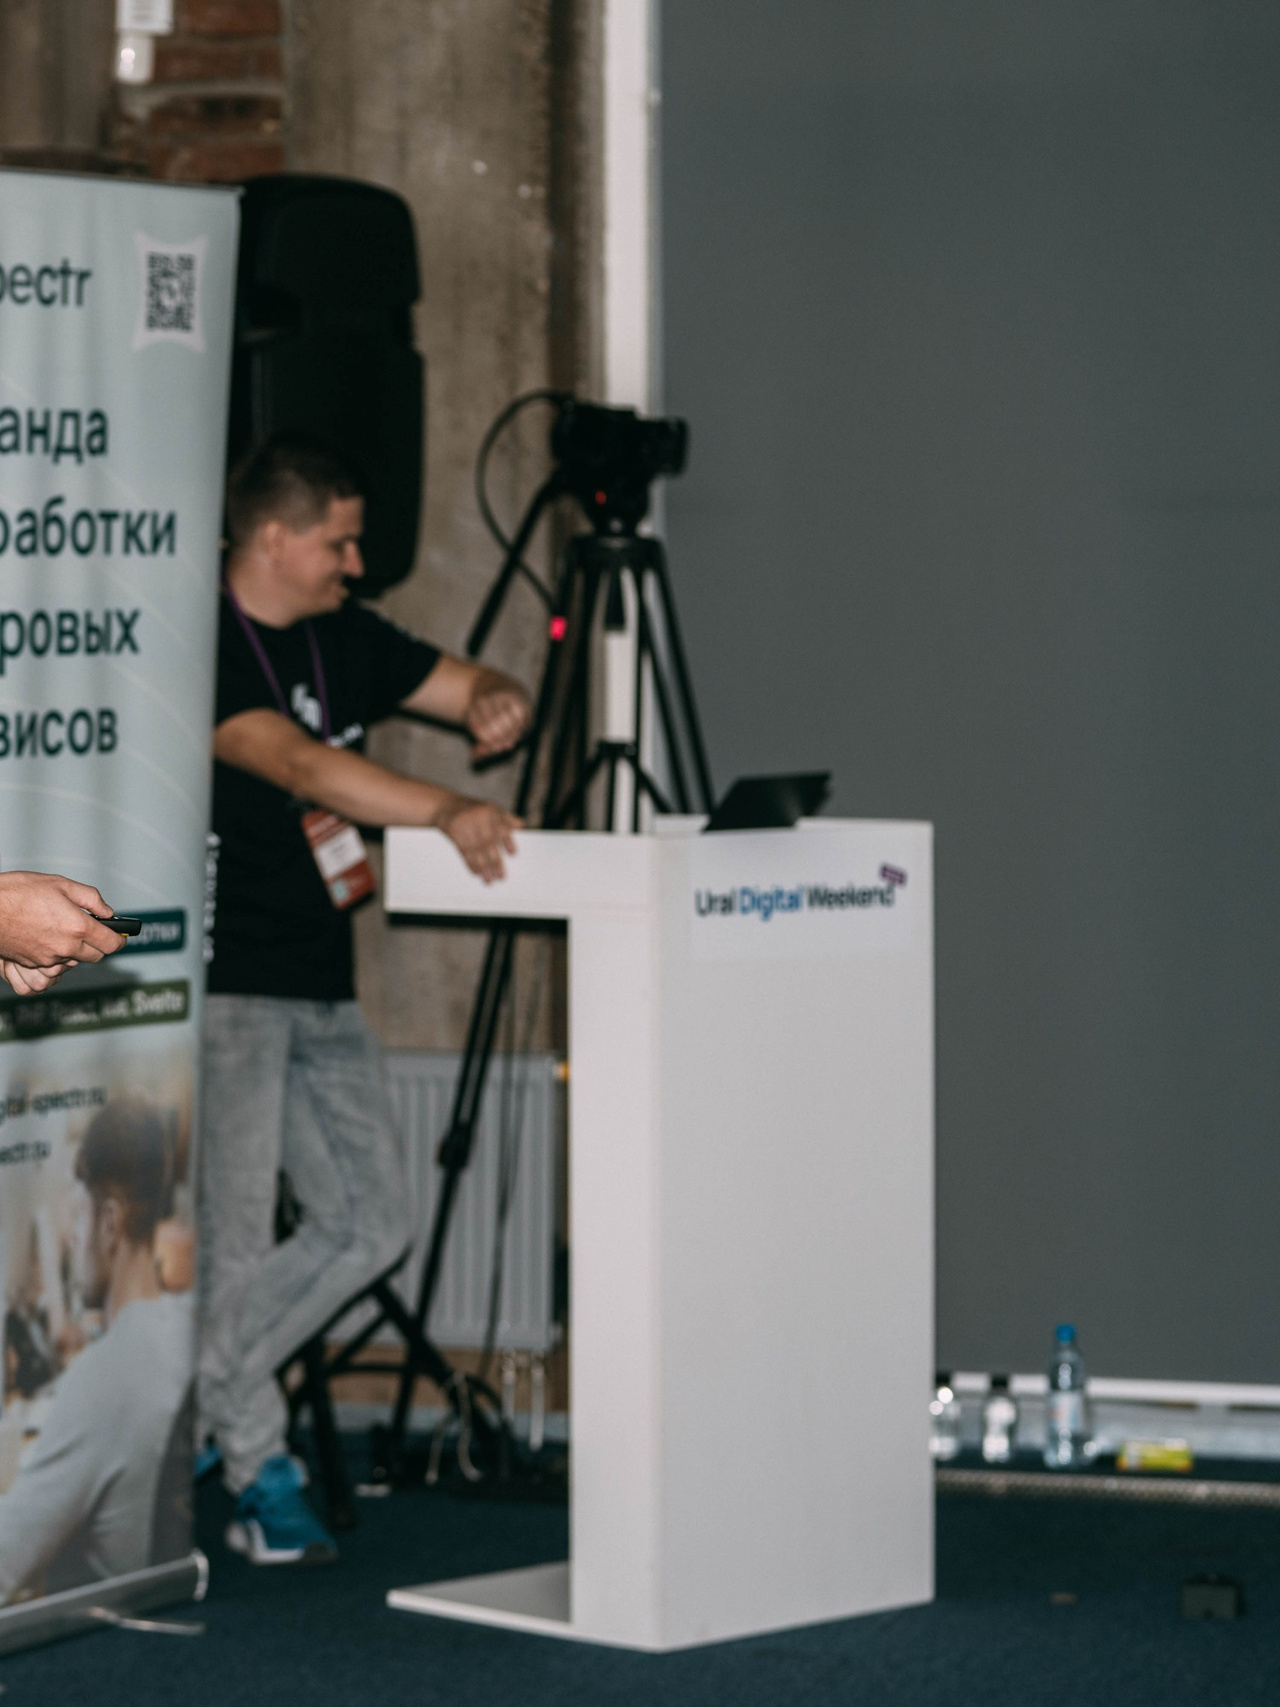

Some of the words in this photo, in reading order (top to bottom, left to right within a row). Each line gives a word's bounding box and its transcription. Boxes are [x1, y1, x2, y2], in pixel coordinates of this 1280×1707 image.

[695, 888, 736, 917] Ural
[739, 885, 803, 922] Digital
[807, 882, 895, 911] Weekend
